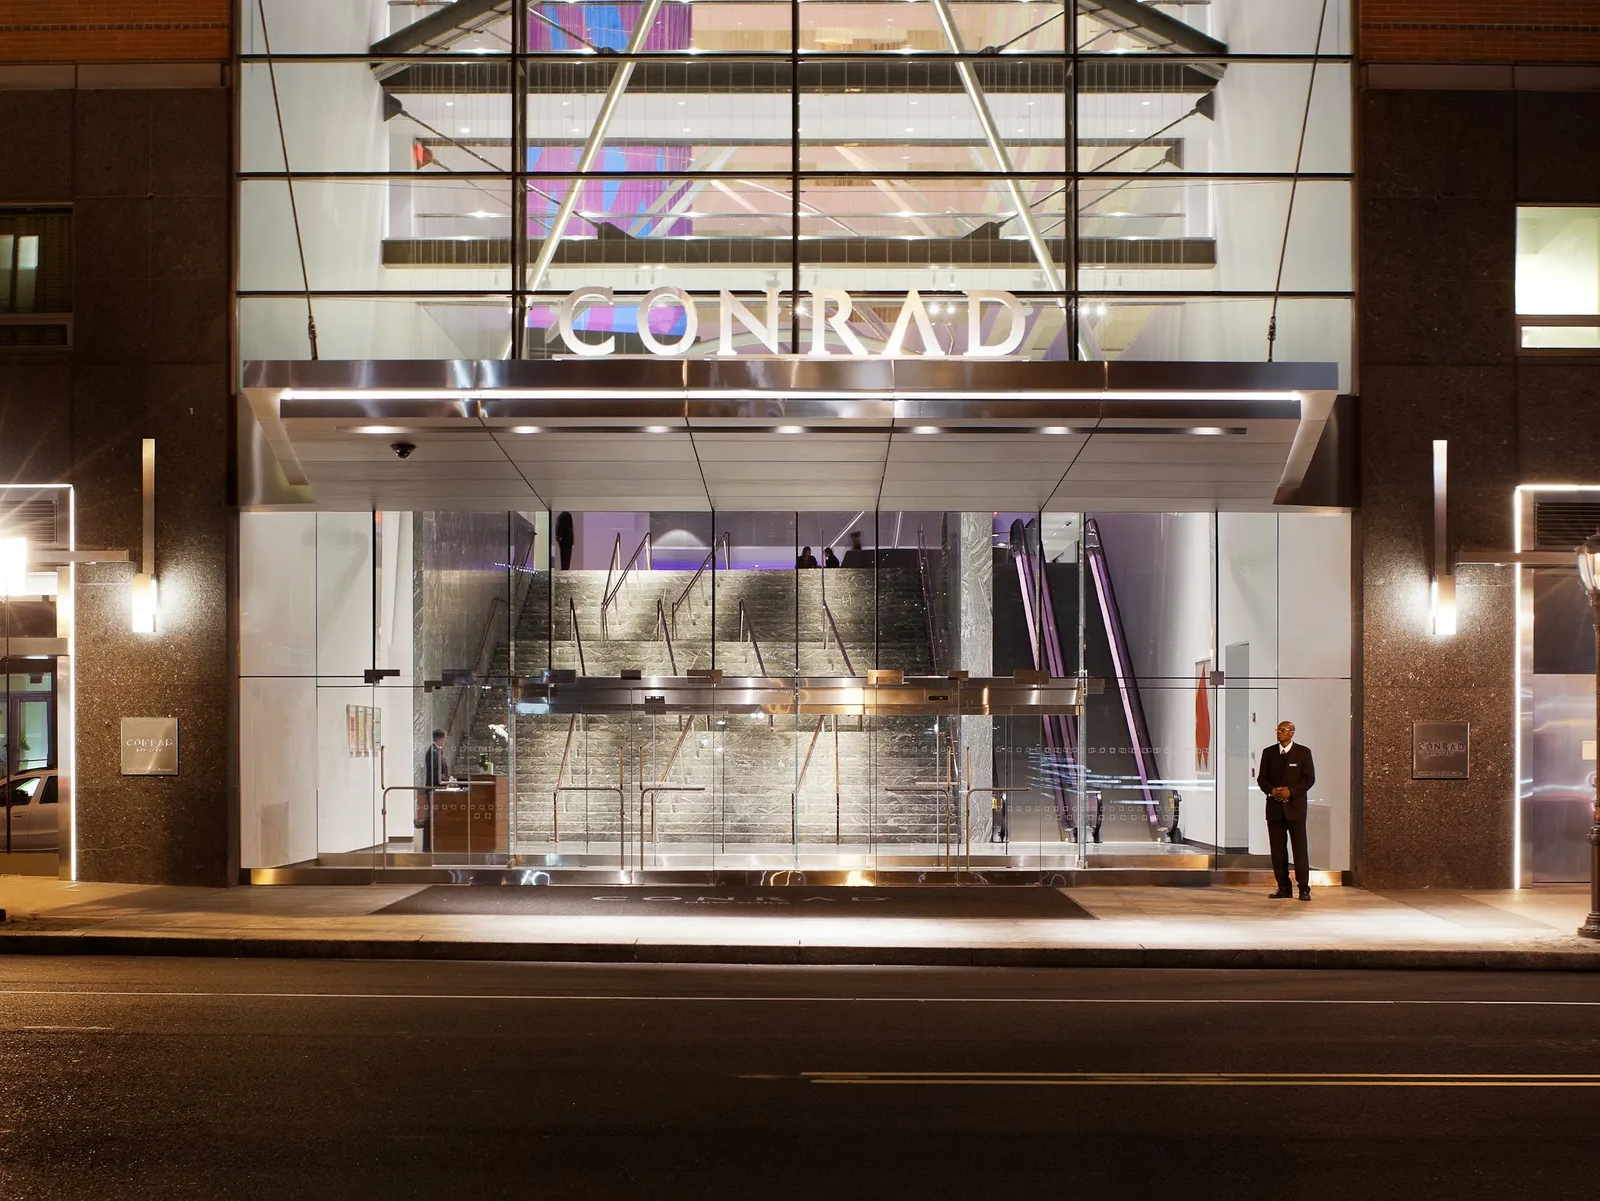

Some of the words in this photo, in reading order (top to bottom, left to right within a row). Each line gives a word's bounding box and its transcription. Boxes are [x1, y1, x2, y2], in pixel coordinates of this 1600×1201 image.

[558, 286, 1026, 356] CONRAD
[126, 739, 174, 747] CONRAD
[1418, 742, 1465, 751] CONRAD
